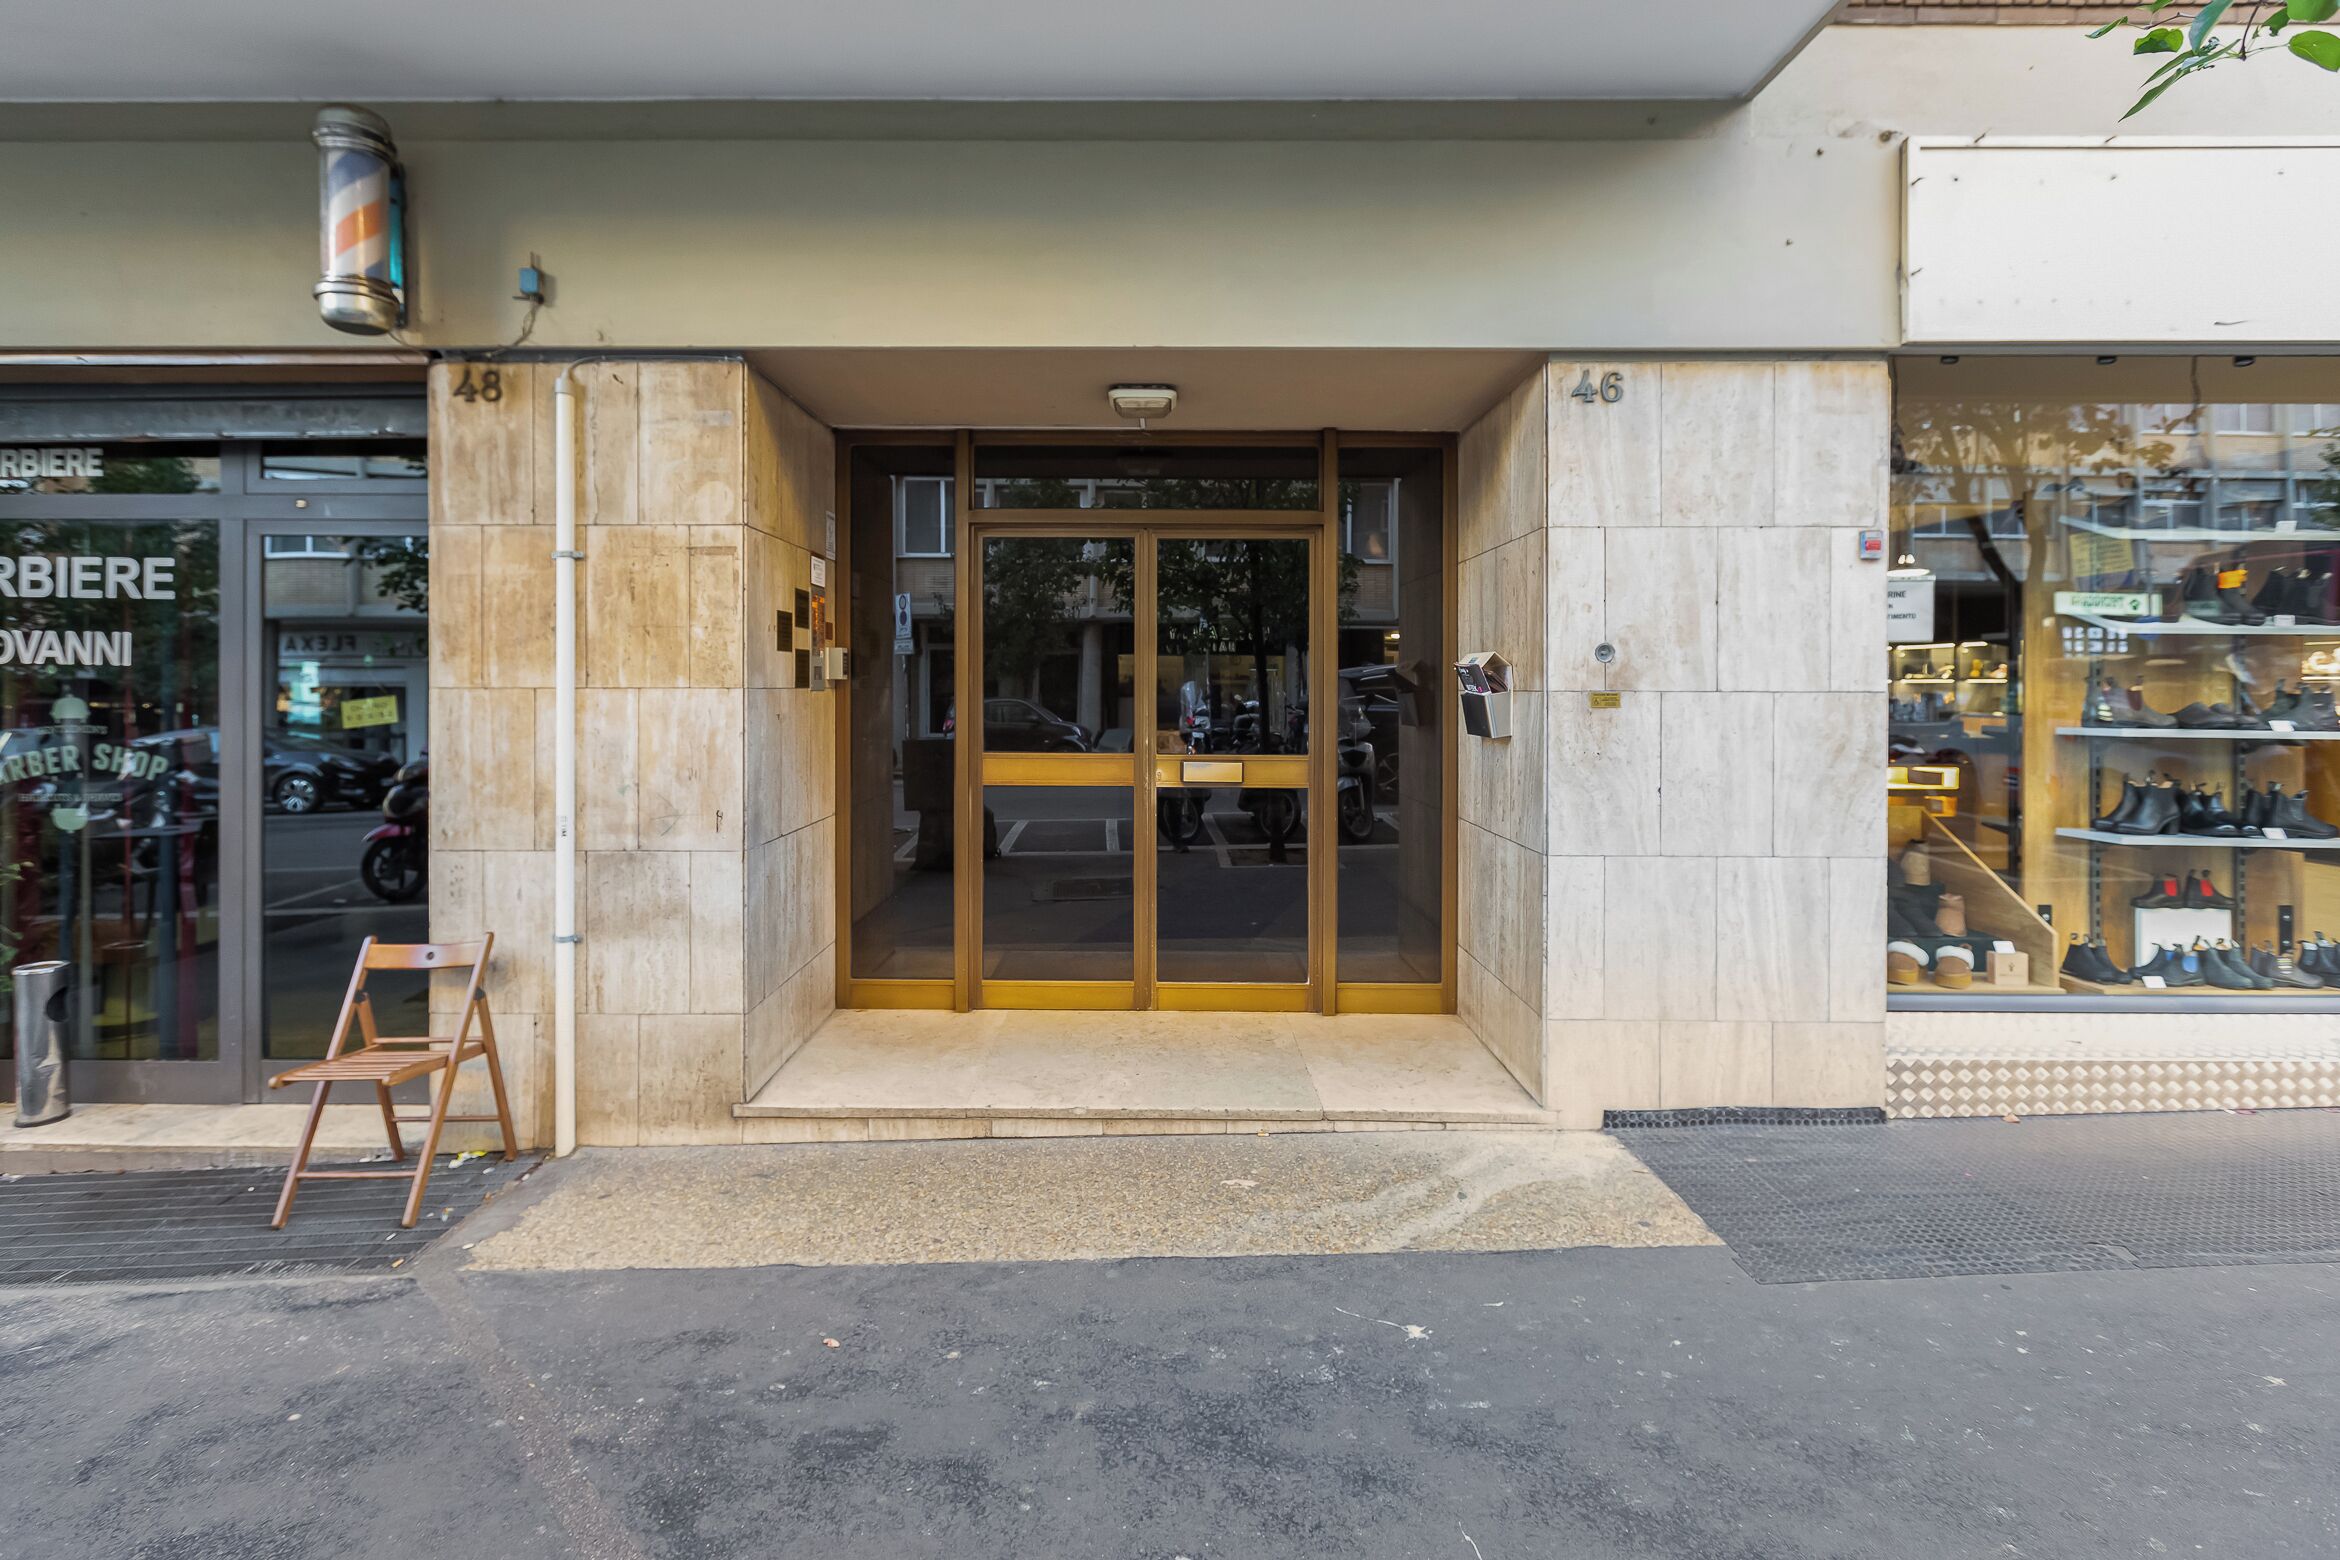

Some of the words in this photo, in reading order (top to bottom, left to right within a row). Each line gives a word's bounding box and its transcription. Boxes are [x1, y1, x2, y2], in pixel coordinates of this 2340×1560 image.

[453, 368, 503, 402] 48
[1571, 369, 1624, 403] 46
[0, 448, 104, 477] RBIERE
[92, 742, 169, 781] SHOP
